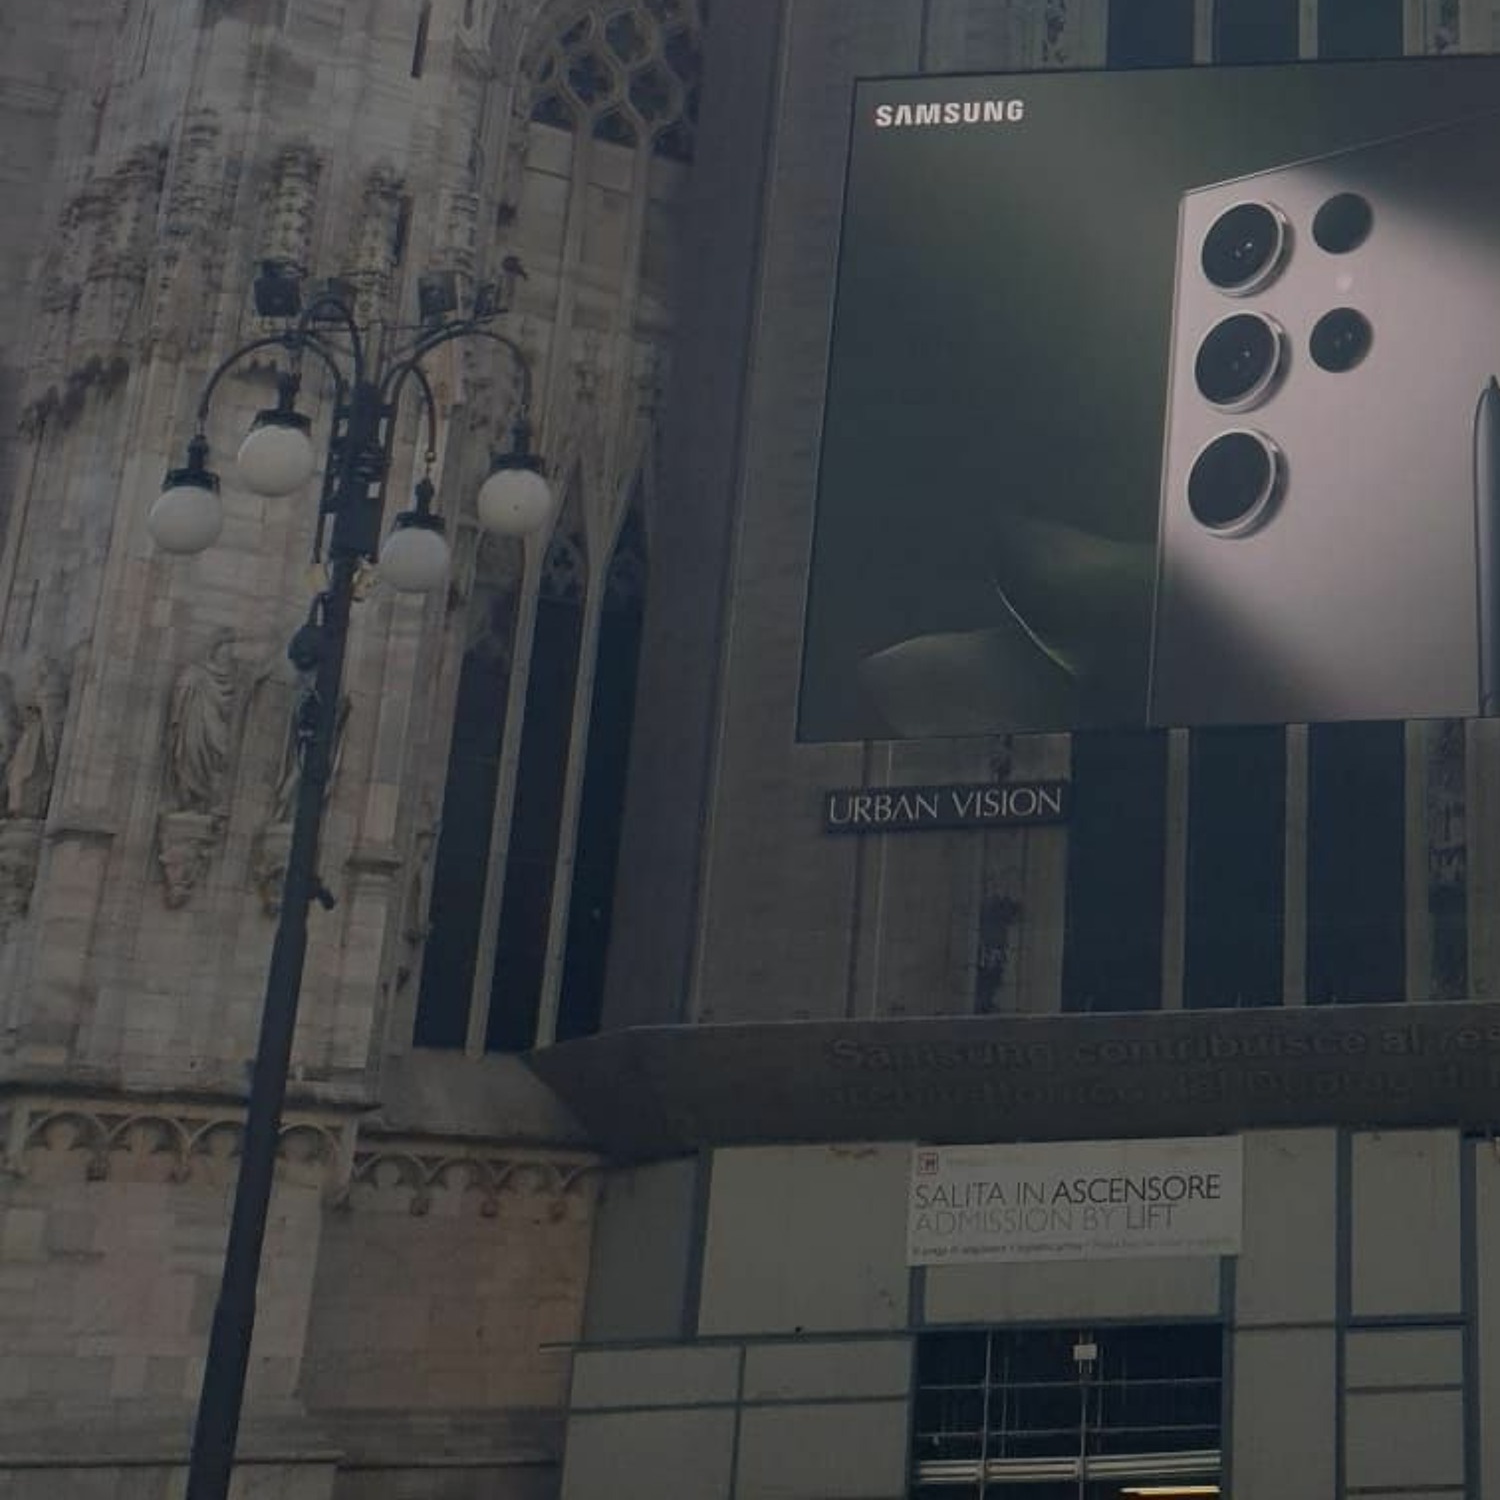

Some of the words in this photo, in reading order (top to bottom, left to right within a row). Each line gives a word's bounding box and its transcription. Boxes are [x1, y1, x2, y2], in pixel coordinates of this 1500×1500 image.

[875, 100, 1024, 127] SAMSUNG
[829, 794, 939, 824] URBAN
[951, 787, 1062, 819] VISION
[915, 1181, 1008, 1209] SALITA
[1016, 1181, 1045, 1205] IN
[1052, 1174, 1222, 1204] ASCENSORE
[915, 1205, 1073, 1235] ADMISSION
[1083, 1206, 1117, 1232] BY
[1126, 1203, 1179, 1230] LIFT
